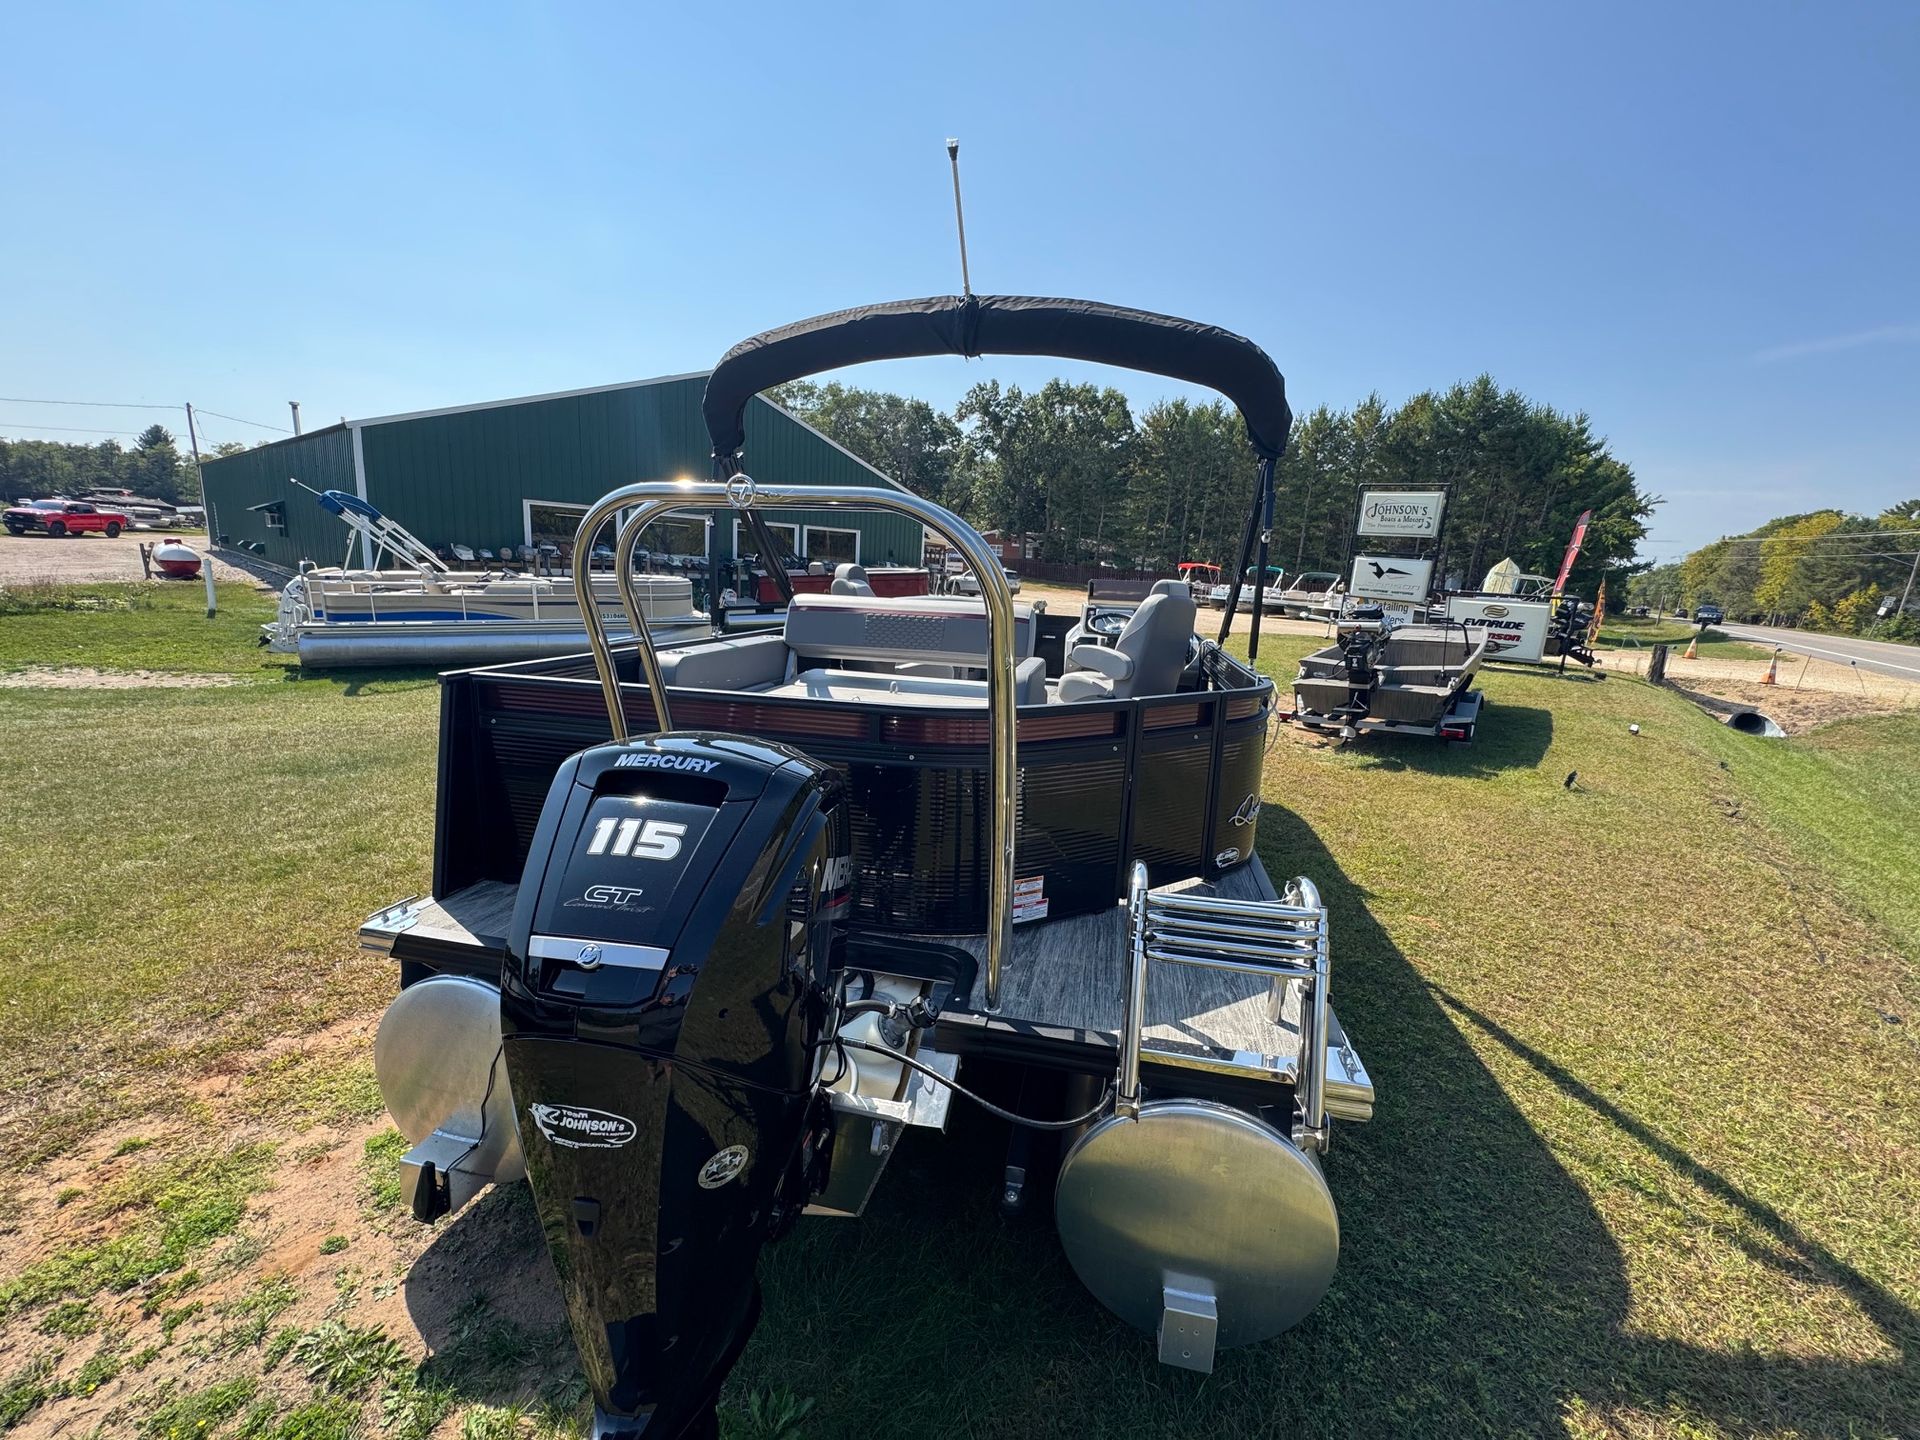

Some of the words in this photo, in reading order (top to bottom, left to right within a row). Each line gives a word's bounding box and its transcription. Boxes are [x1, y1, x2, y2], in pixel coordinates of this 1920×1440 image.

[1371, 503, 1428, 517] JOHNSON'S
[1463, 618, 1526, 631] EVINRUDE
[1488, 632, 1522, 642] nson
[614, 753, 721, 773] MERCURY
[587, 817, 688, 862] 115
[560, 1117, 625, 1134] JOHNSON's
